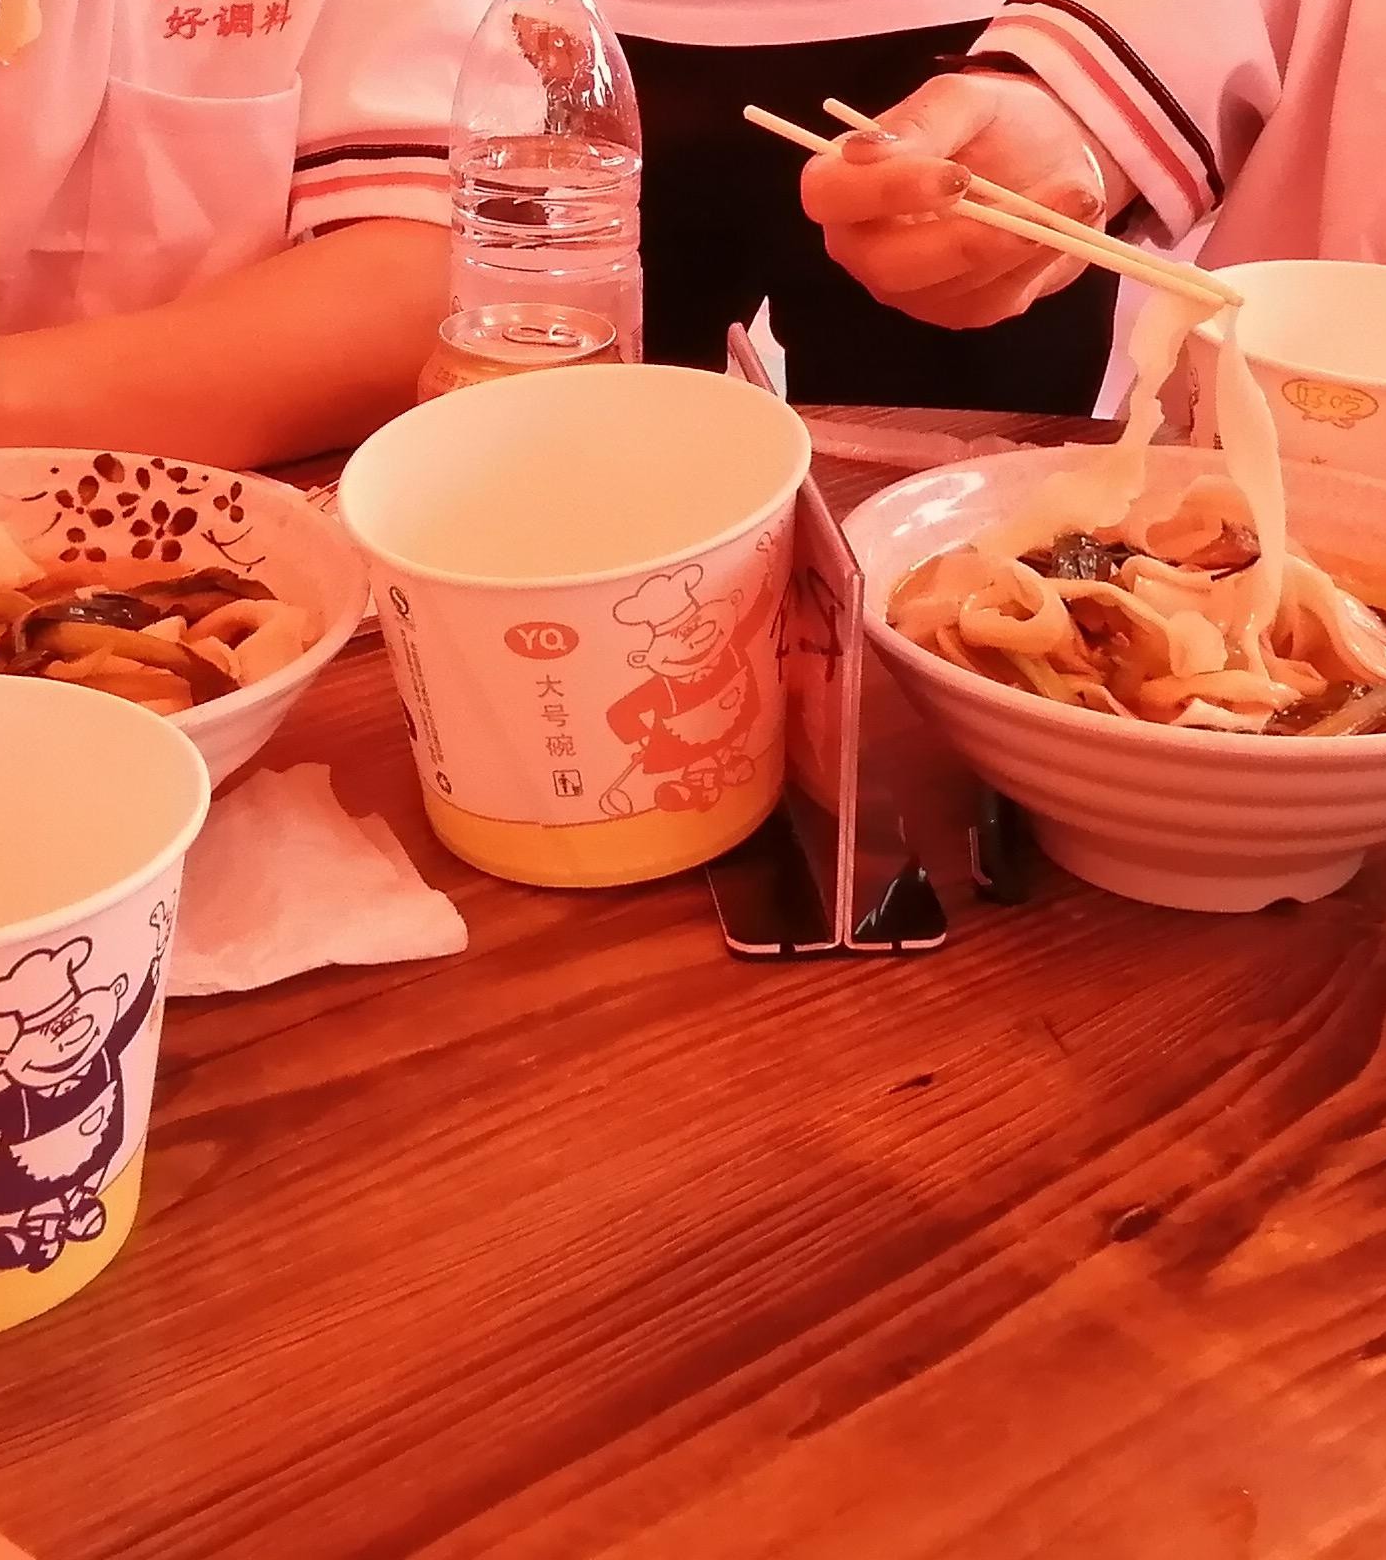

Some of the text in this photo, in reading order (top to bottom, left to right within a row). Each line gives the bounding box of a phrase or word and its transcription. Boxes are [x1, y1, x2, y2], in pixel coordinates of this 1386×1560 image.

[516, 627, 568, 652] YQ
[535, 674, 577, 758] 大号碗
